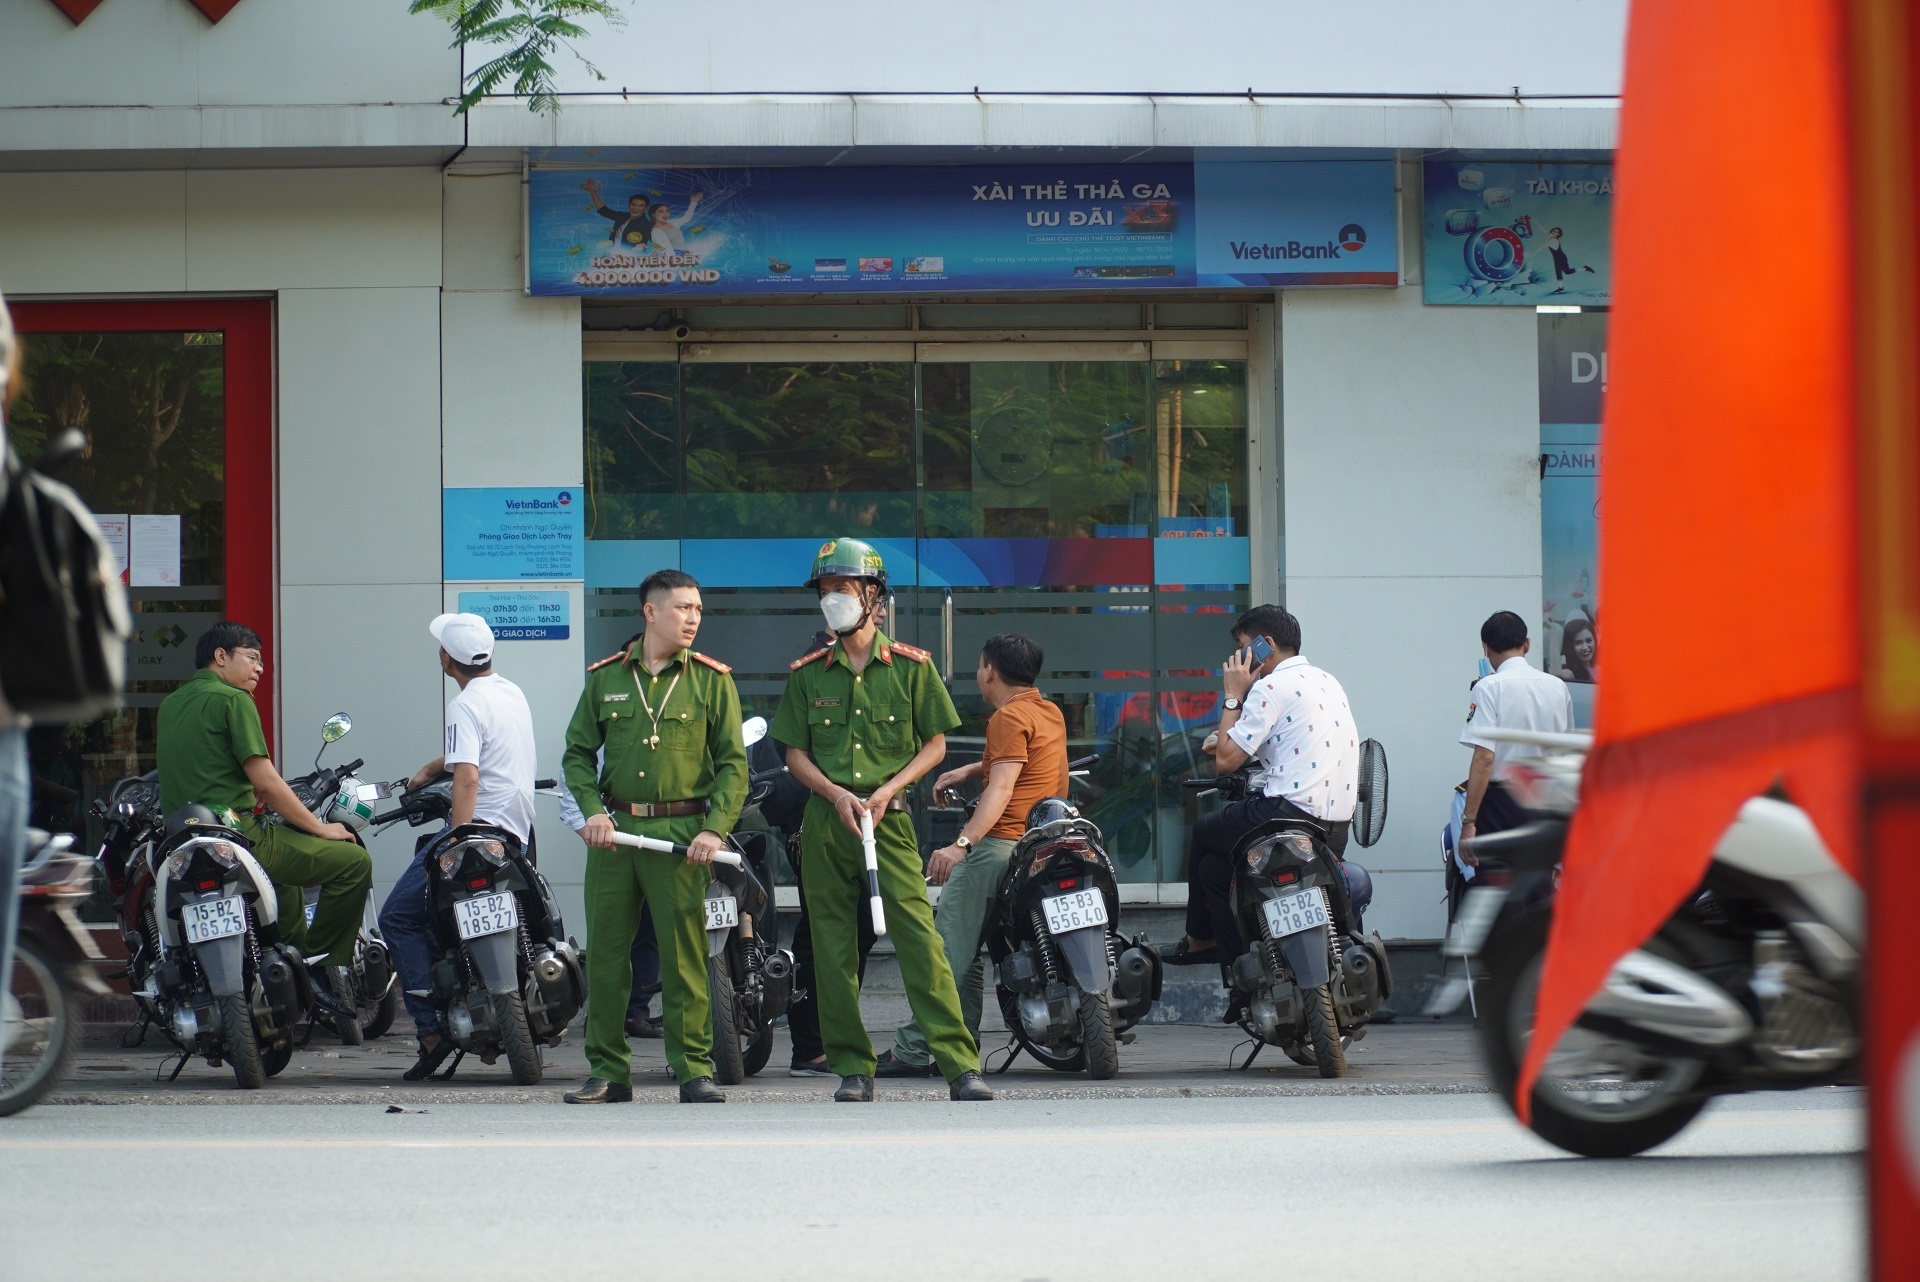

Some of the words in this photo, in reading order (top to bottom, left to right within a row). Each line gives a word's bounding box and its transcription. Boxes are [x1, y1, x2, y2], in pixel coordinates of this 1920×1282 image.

[971, 181, 1014, 201] XÀI
[1021, 180, 1068, 201] THẺ
[1074, 179, 1126, 199] THẢ
[1132, 183, 1171, 199] GA
[1525, 177, 1555, 195] TÀI
[1559, 176, 1615, 195] KHOẢ
[1026, 210, 1060, 227] ƯU
[1068, 207, 1113, 227] ĐÃI
[1229, 240, 1342, 260] VietinBank
[591, 253, 635, 268] HOÀN
[572, 271, 677, 287] 4.000.000
[678, 269, 721, 285] VND
[1571, 351, 1609, 393] DỊ
[1547, 449, 1596, 469] DÀNH
[505, 499, 559, 509] VietinBank
[479, 532, 501, 542] Phòng
[503, 532, 520, 541] Giao
[522, 532, 537, 542] Dịch
[539, 532, 556, 542] Lạch
[558, 532, 573, 541] Tray
[513, 523, 534, 531] nhánh
[535, 523, 548, 533] Ngô
[470, 605, 491, 614] Sáng
[493, 605, 518, 613] 07h30
[538, 604, 561, 612] 11h30
[495, 616, 518, 624] 13h30
[502, 630, 524, 638] GIAO
[525, 629, 547, 639] DỊCH
[192, 900, 234, 921] 15-B2
[464, 895, 506, 918] 15-B2
[705, 900, 727, 914] -B1
[1052, 892, 1094, 913] 15-B3
[1273, 892, 1315, 916] 15-B2
[191, 915, 242, 940] 165.25
[463, 910, 512, 936] 185.27
[1050, 907, 1104, 931] 556.40
[1272, 907, 1325, 935] 218.86
